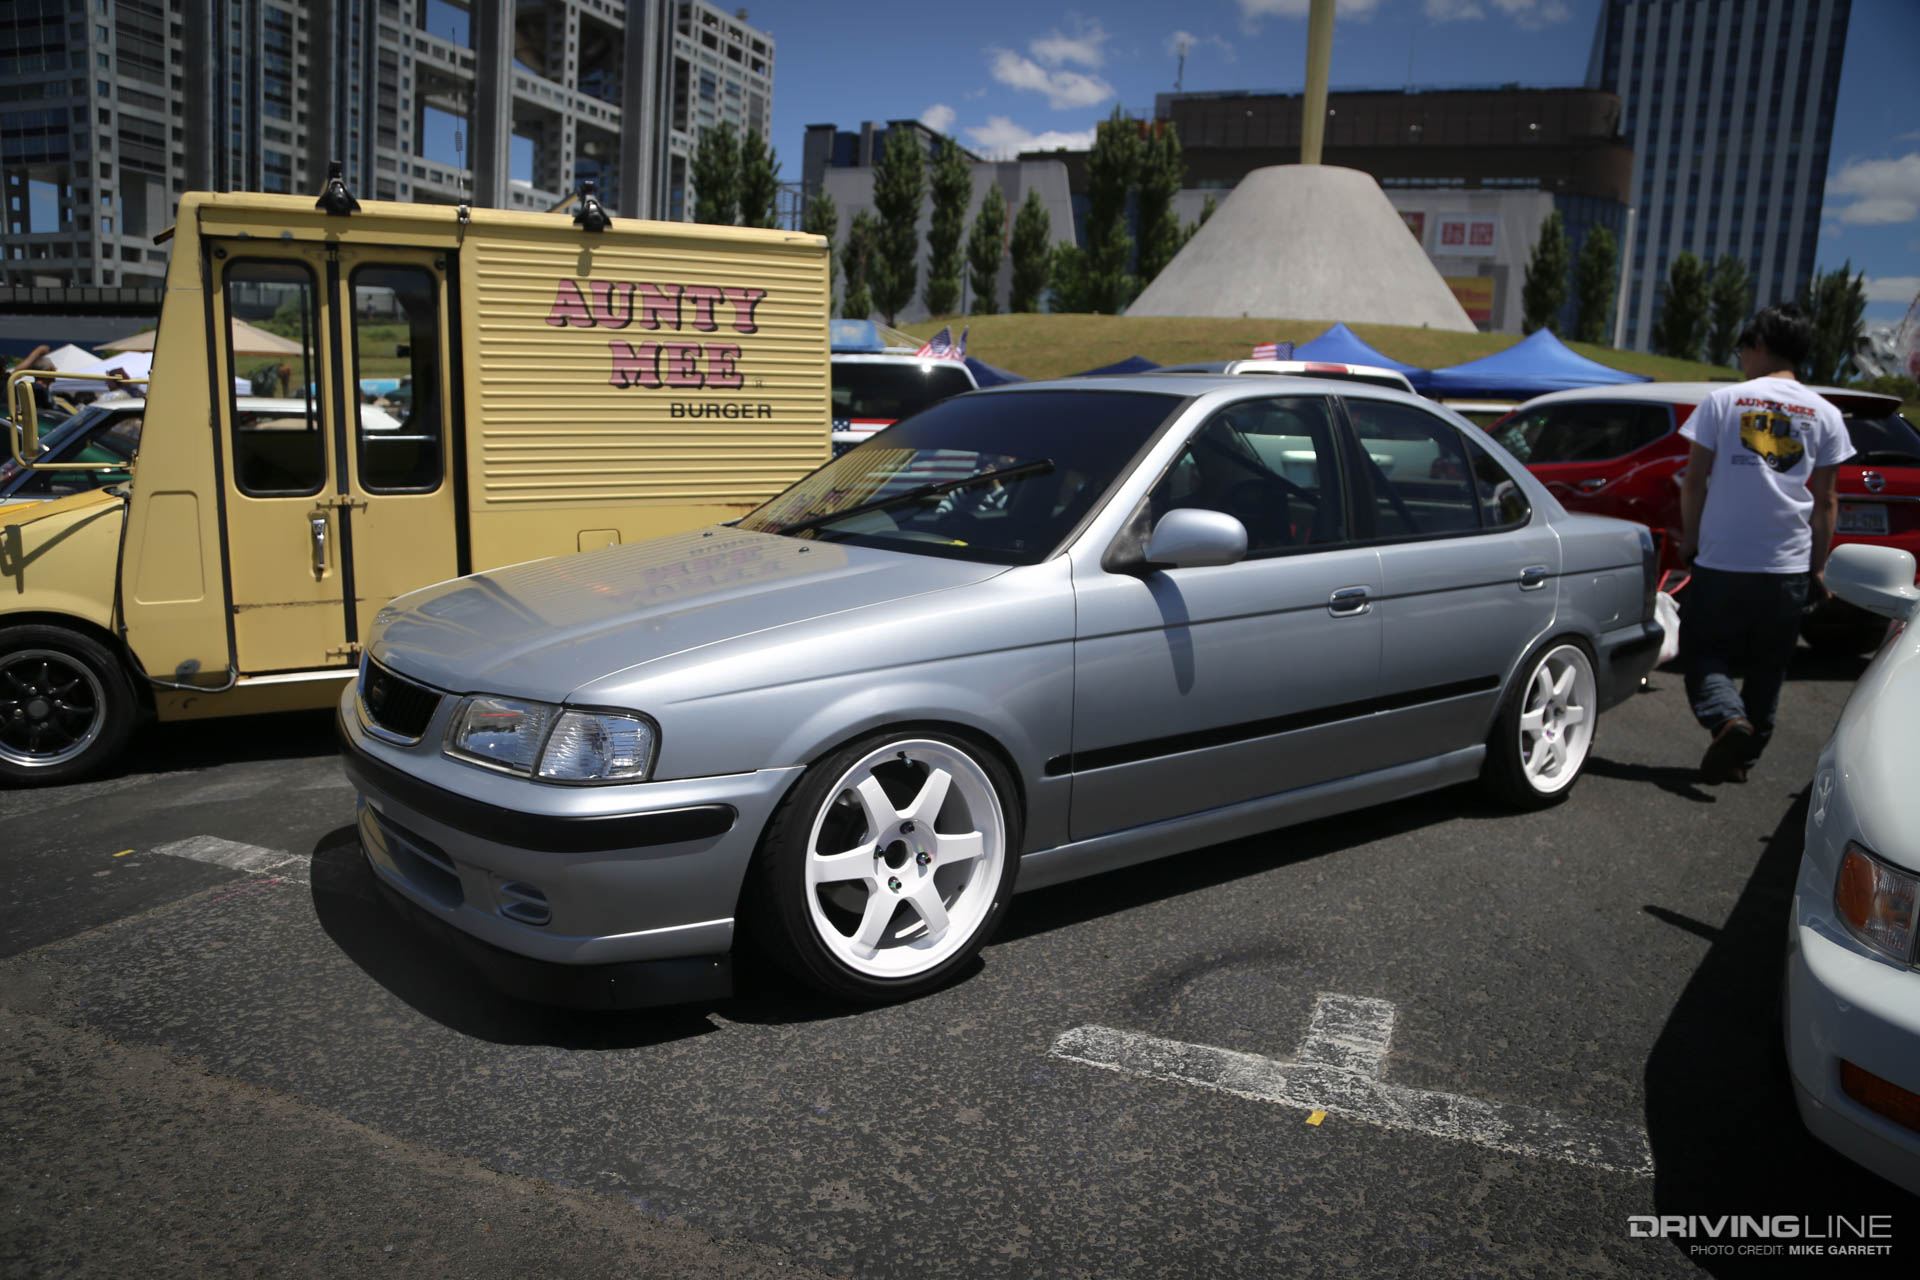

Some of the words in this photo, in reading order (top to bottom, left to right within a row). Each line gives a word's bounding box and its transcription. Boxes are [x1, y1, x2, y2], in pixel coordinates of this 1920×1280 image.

[545, 278, 767, 334] AUNTY
[608, 340, 744, 390] MEE
[670, 403, 772, 419] BURGER
